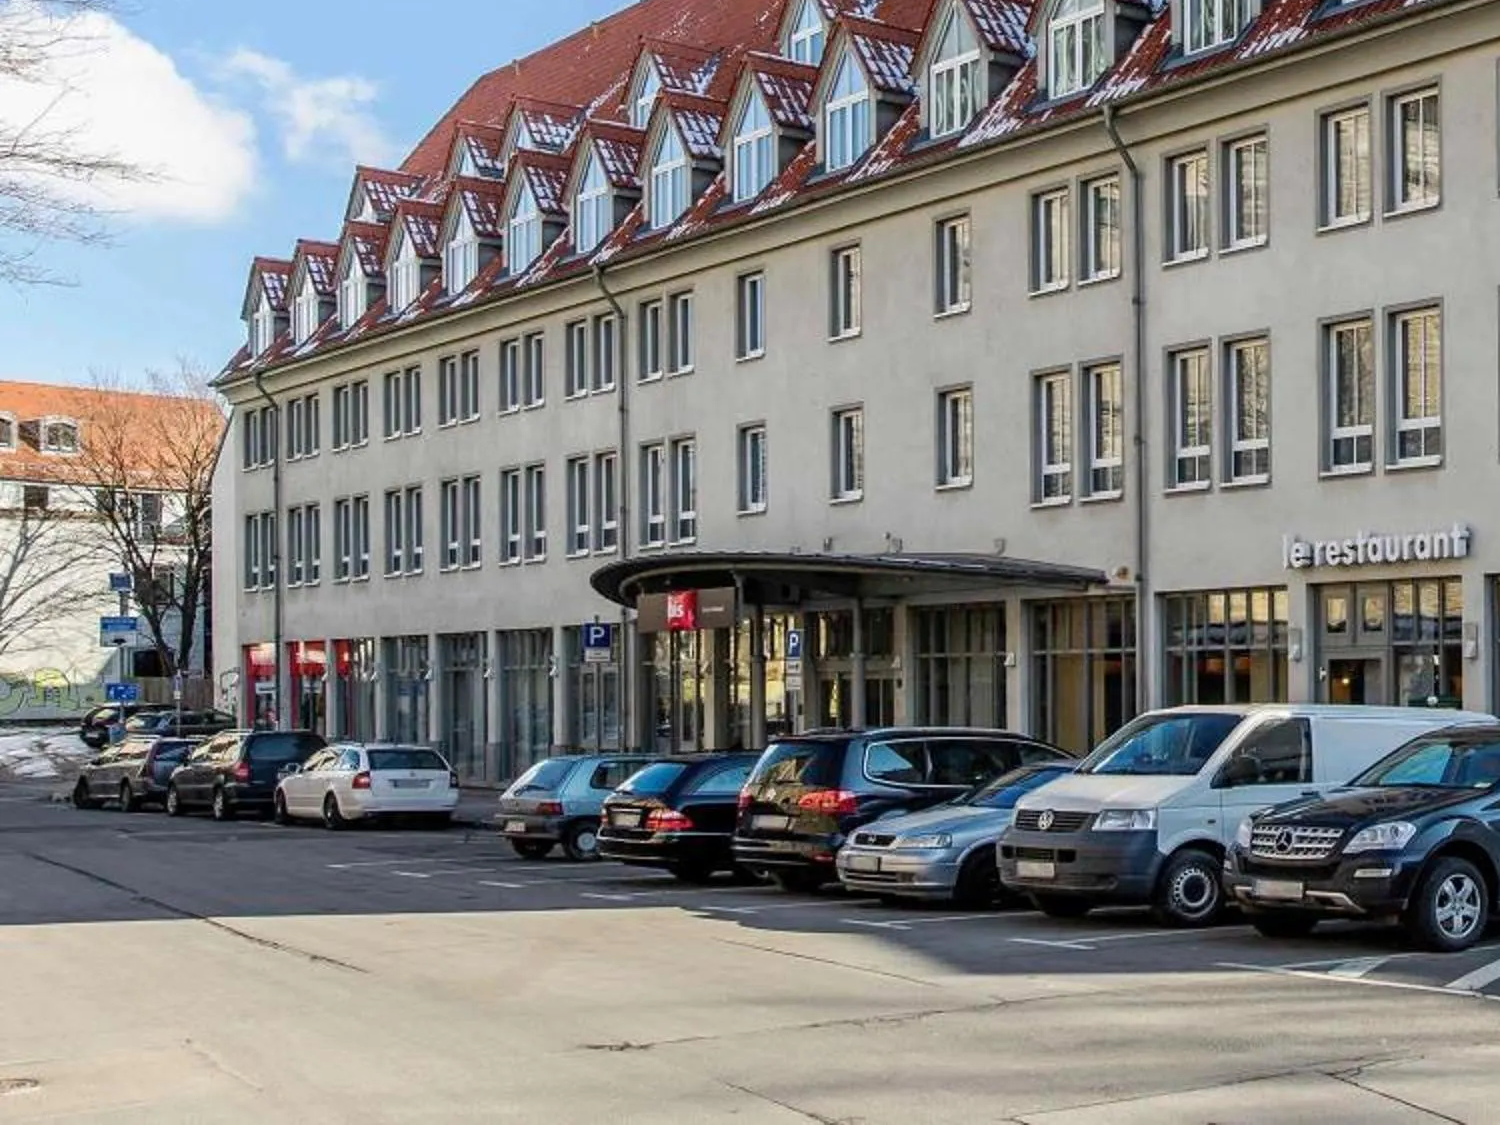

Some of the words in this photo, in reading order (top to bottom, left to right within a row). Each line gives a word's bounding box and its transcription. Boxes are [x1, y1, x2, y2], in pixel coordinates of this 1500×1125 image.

[1283, 533, 1312, 569] le
[1314, 521, 1470, 566] restaurant
[590, 626, 605, 646] P
[788, 633, 799, 656] P
